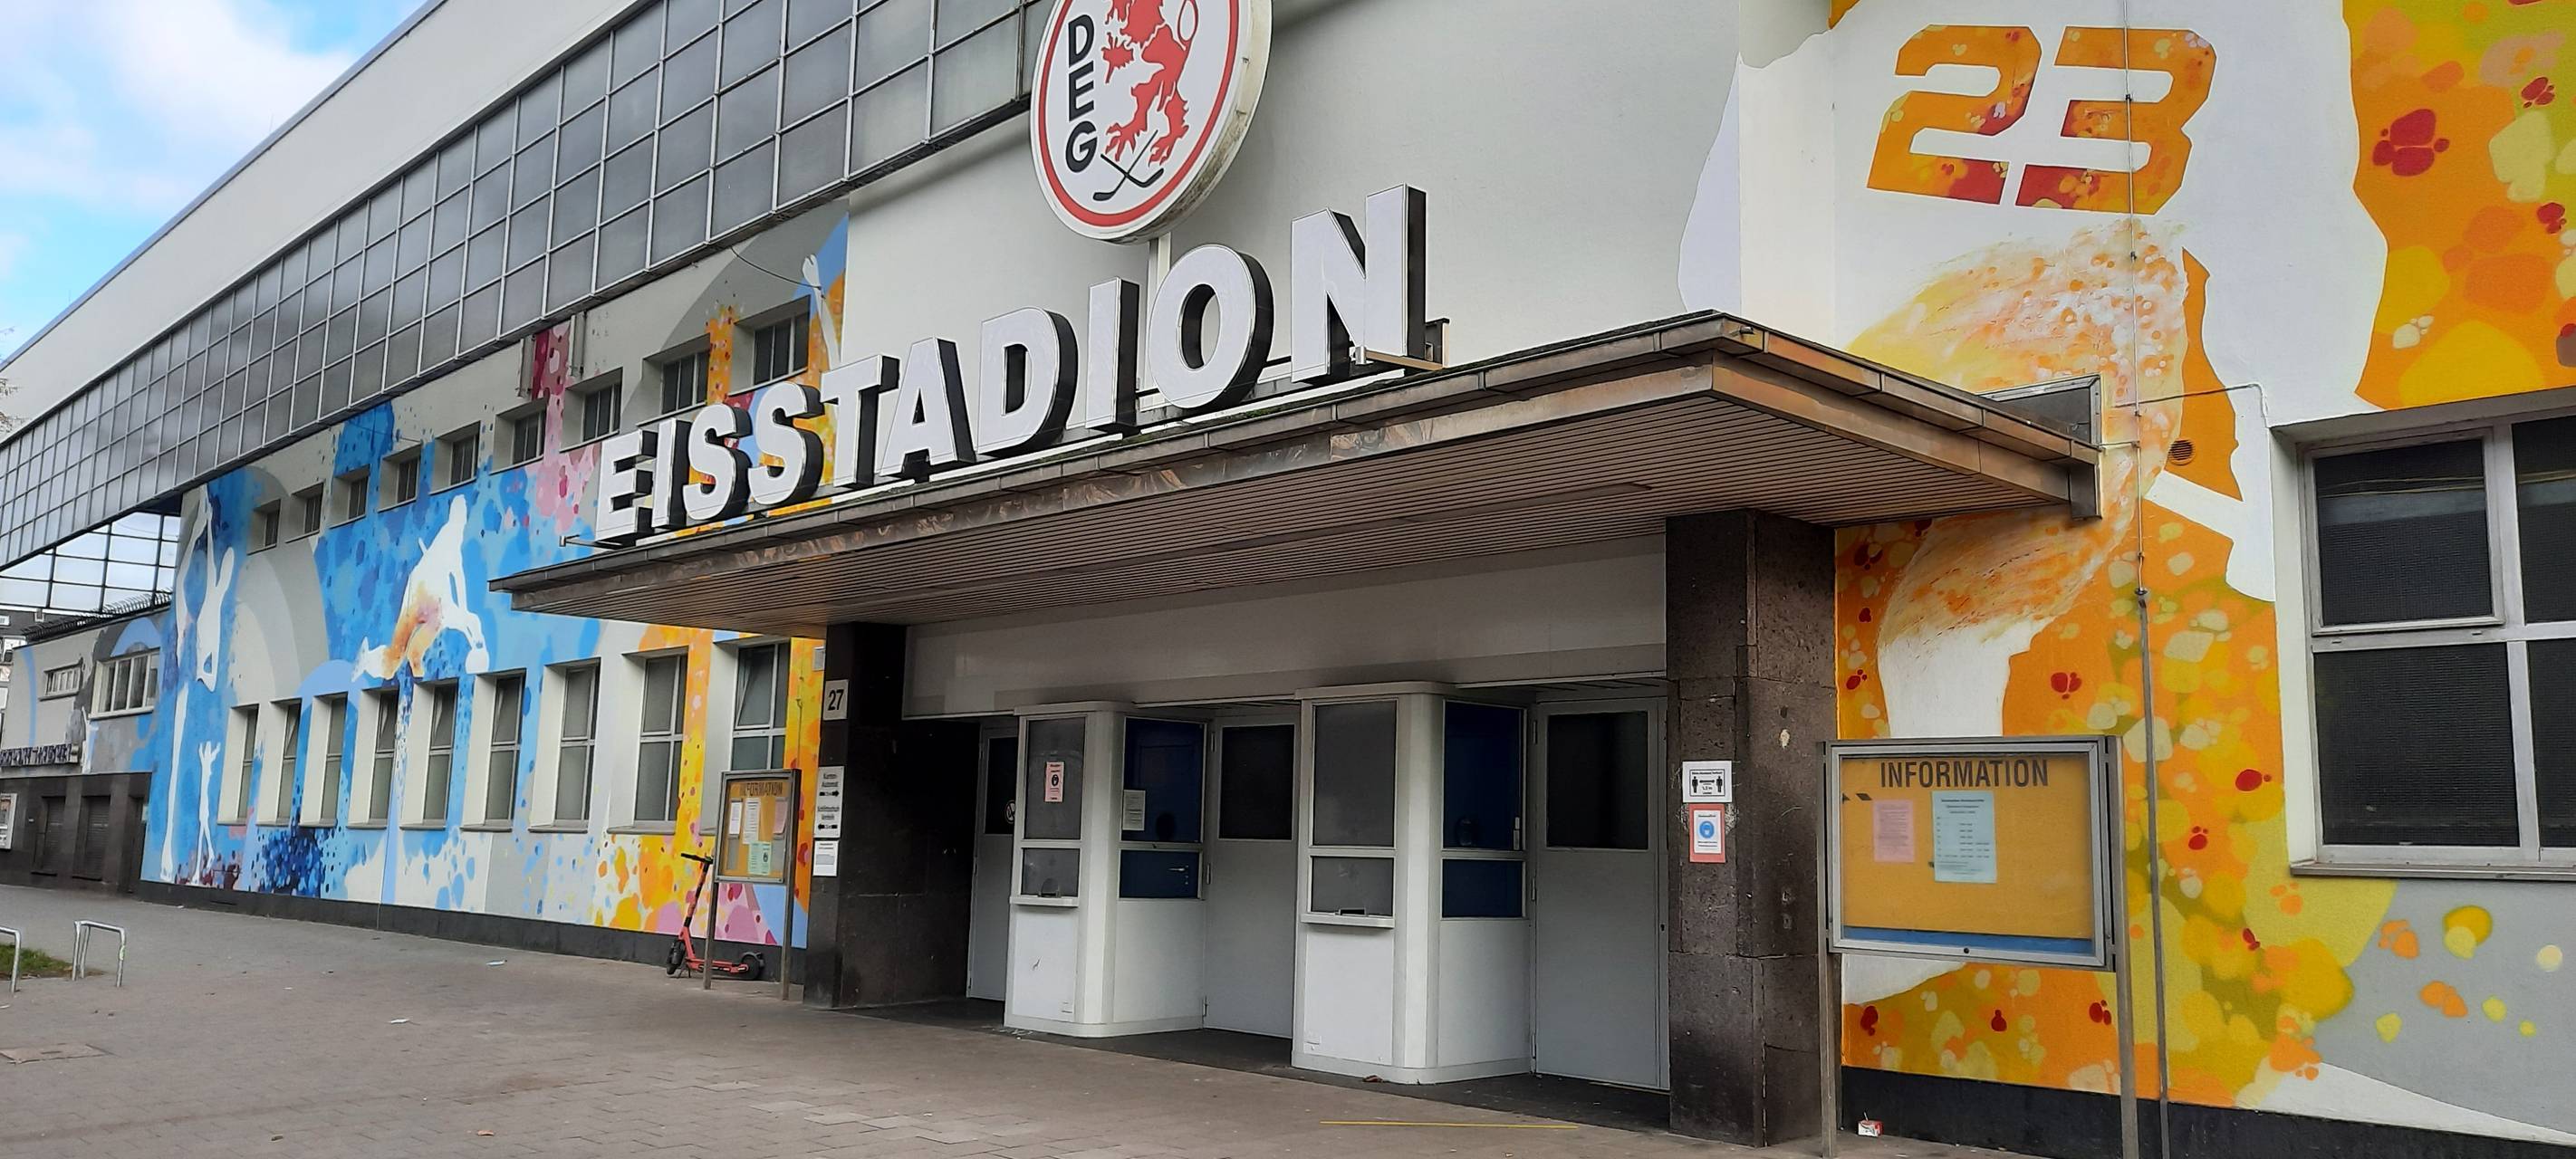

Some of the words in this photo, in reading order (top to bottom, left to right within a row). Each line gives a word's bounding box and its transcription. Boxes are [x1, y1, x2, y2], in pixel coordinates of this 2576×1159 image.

[1065, 14, 1098, 173] DEG
[1866, 24, 2217, 216] 23
[595, 183, 1426, 545] EISSTADION
[827, 688, 844, 712] 27
[1880, 759, 2049, 789] INFORMATION
